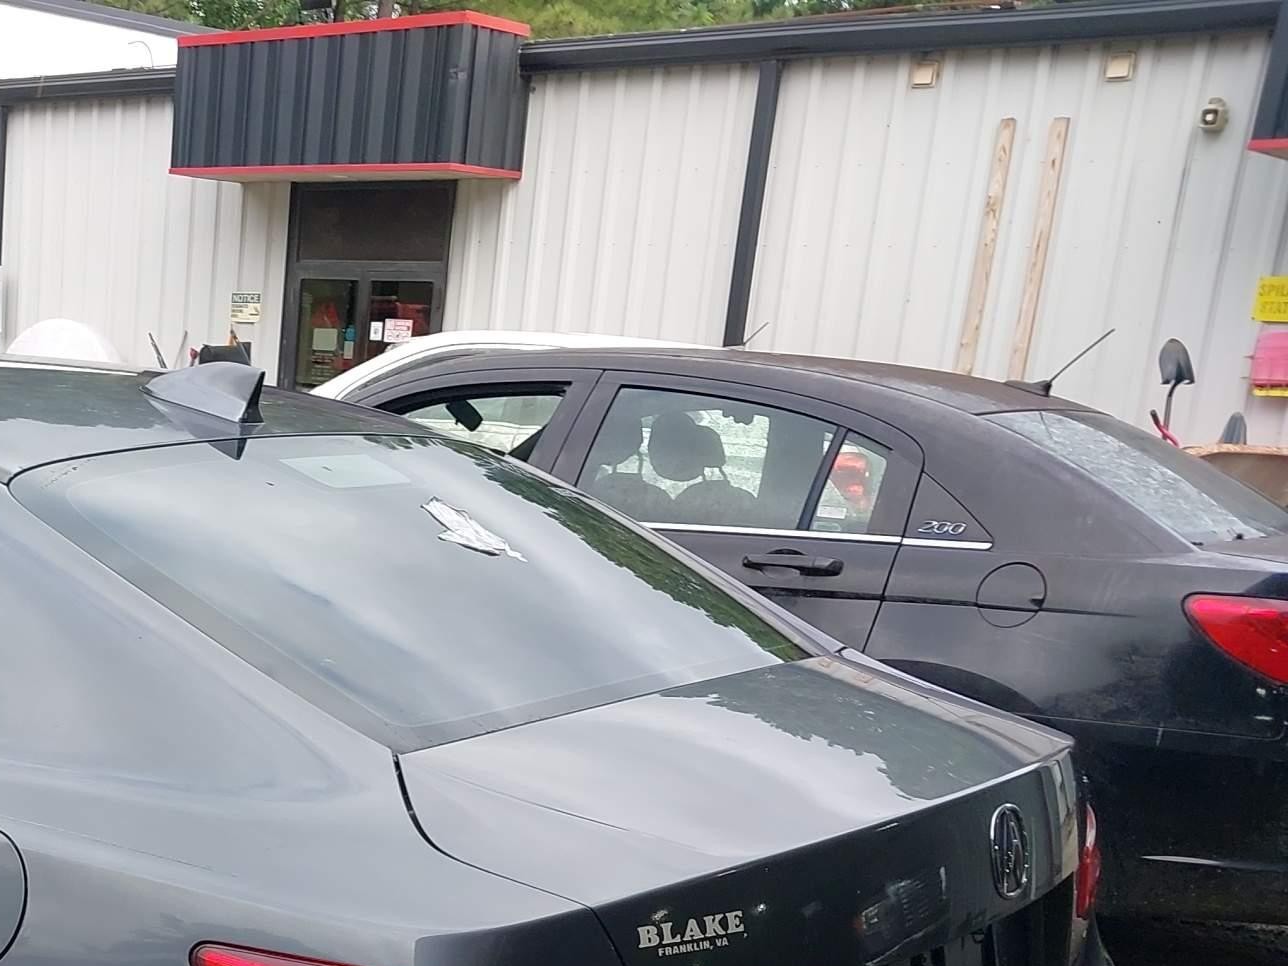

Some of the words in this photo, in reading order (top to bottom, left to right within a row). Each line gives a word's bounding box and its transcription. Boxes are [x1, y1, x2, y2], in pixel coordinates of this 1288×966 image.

[232, 294, 261, 303] NOTICE
[917, 520, 967, 535] 200
[637, 910, 745, 949] BLAKE
[658, 940, 713, 957] FRANKLIN,
[715, 937, 729, 947] VA
